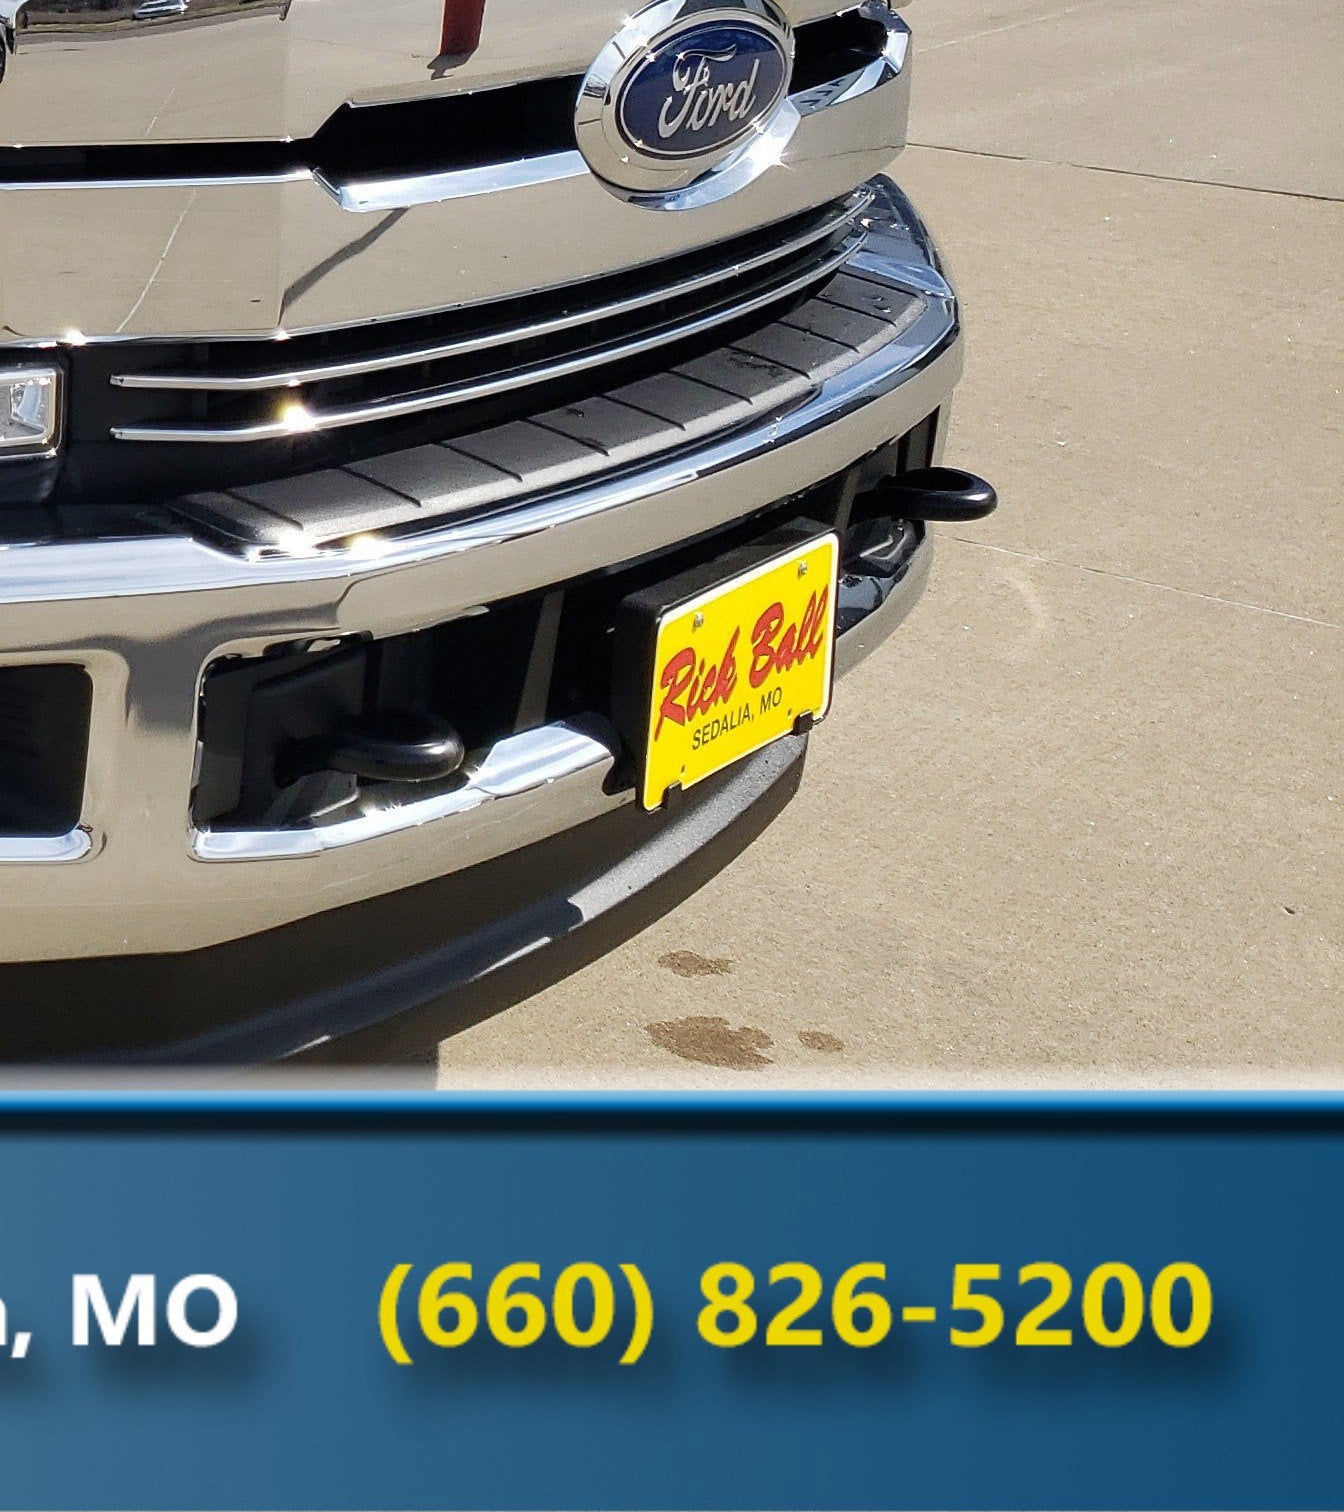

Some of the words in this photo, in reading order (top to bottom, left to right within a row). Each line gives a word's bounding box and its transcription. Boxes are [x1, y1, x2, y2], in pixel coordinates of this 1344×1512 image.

[659, 44, 759, 138] Ford
[654, 626, 741, 742] Rick
[749, 584, 829, 689] Ball
[692, 704, 755, 751] SEDALIA,
[759, 686, 783, 717] MO
